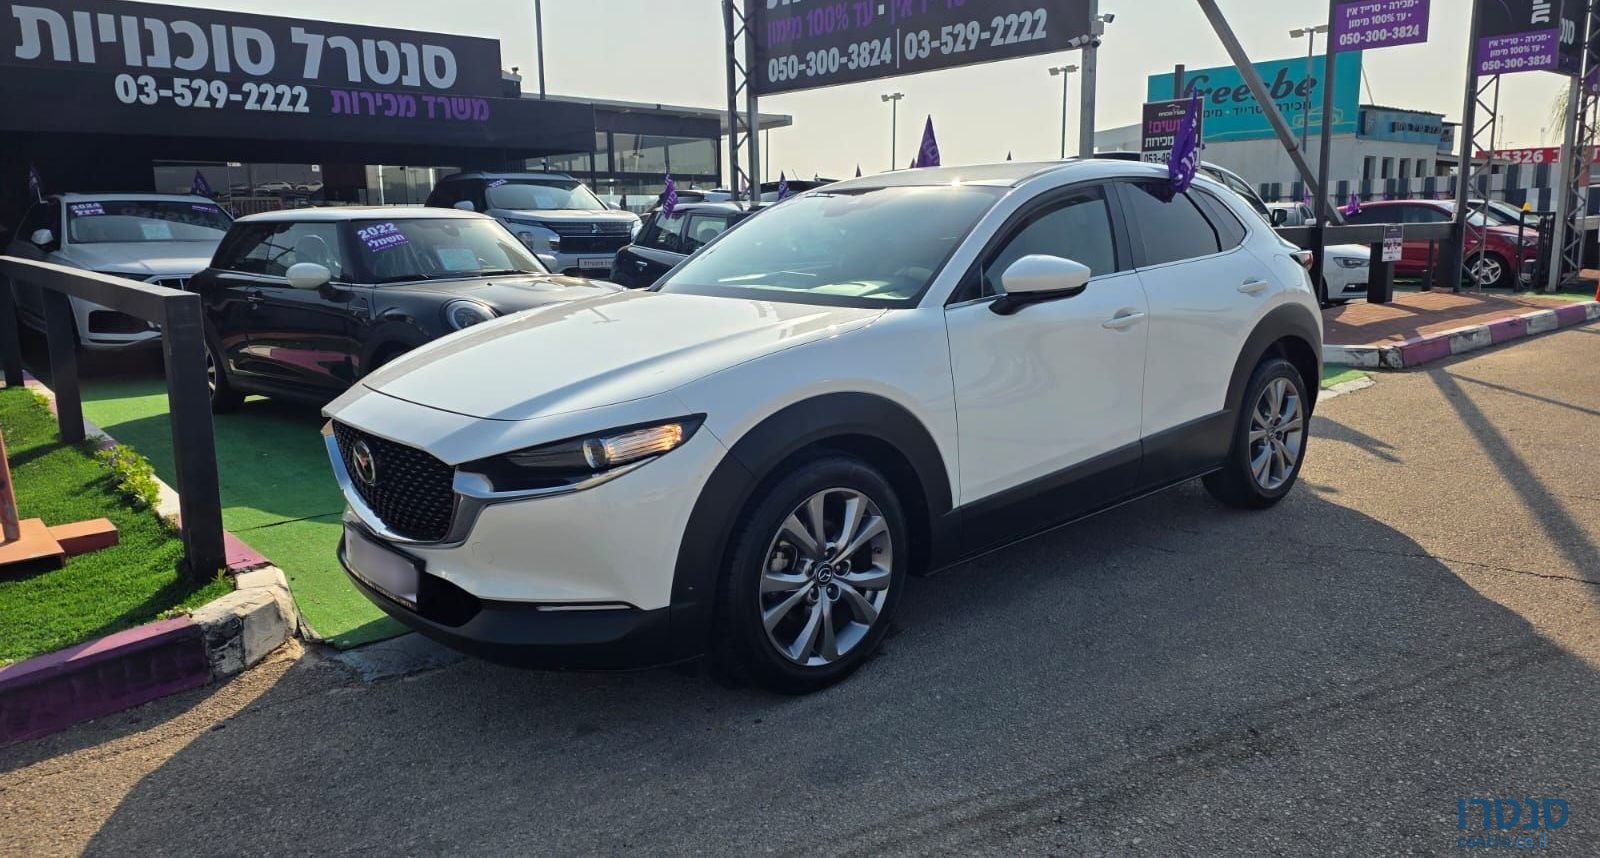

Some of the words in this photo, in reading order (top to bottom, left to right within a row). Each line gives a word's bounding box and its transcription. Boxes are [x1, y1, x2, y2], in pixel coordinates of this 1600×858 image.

[806, 5, 849, 37] 100%
[1348, 17, 1370, 30] מימון
[1372, 13, 1395, 25] 100%
[1396, 13, 1407, 22] עד
[12, 4, 275, 76] סוכנויות
[904, 8, 1048, 60] 03-529-2222
[1339, 24, 1420, 46] 050-300-3824
[293, 26, 457, 89] סנטרל
[768, 37, 892, 83] 050-300-3824
[1510, 45, 1531, 55] 100%
[1481, 54, 1552, 72] 050-300-3824
[115, 73, 310, 115] 03-529-2222
[331, 89, 416, 118] מכירות
[422, 95, 490, 121] משרד
[357, 222, 398, 240] 2022
[367, 233, 406, 248] חשמלי
